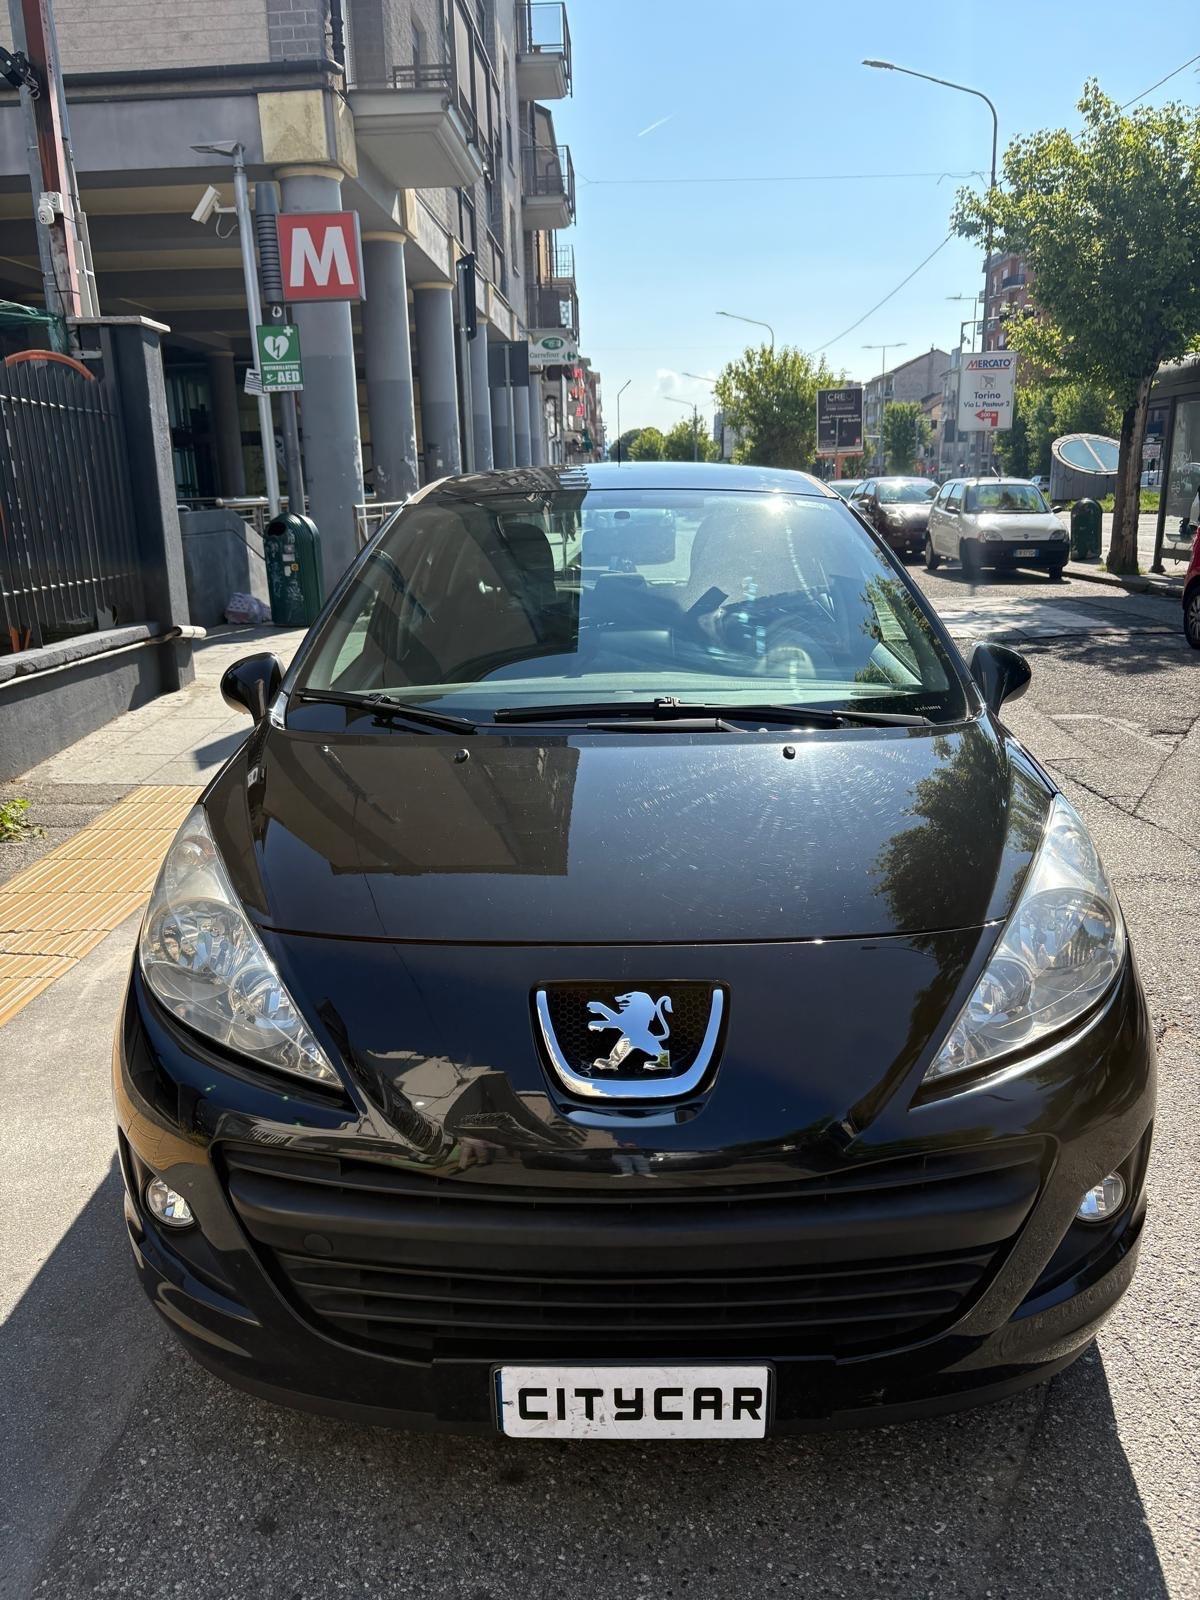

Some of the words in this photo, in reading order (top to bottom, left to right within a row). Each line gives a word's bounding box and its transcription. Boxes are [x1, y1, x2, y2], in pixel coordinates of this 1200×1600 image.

[289, 226, 354, 287] M
[277, 371, 301, 383] AED
[974, 391, 1001, 400] Torino
[518, 1387, 763, 1421] CITYCAR
